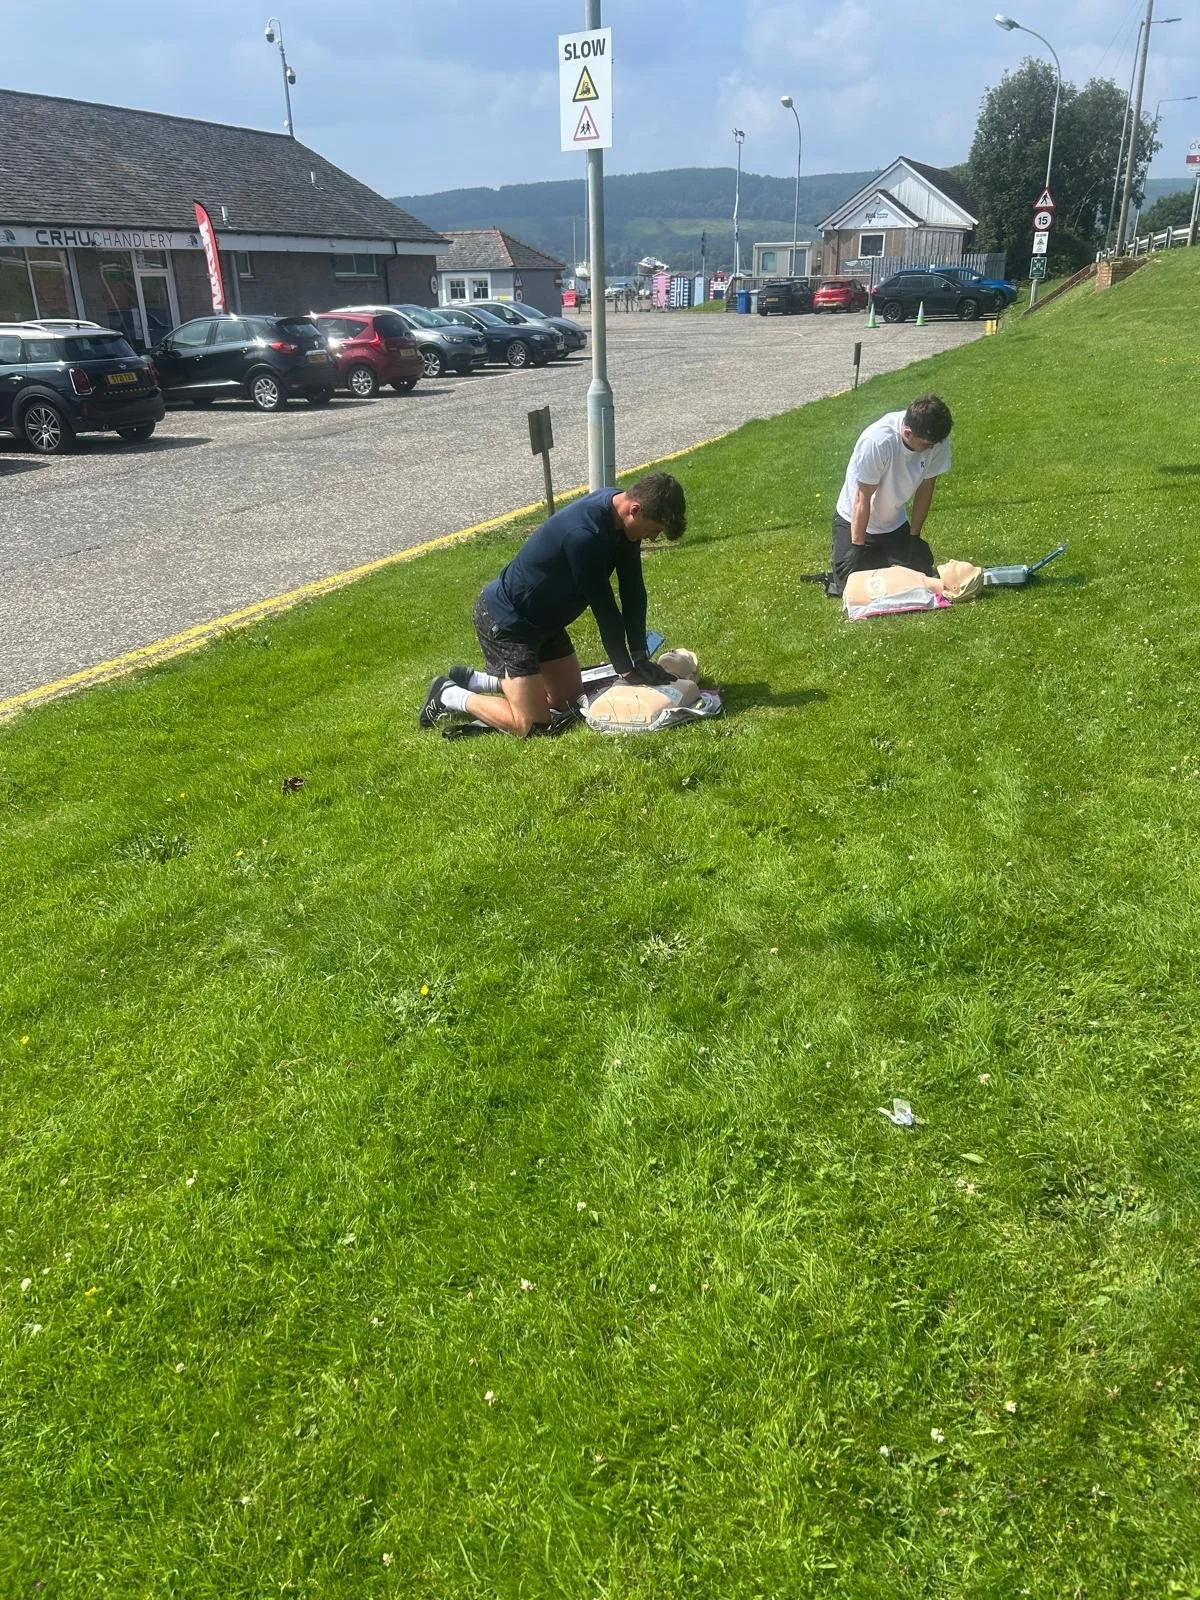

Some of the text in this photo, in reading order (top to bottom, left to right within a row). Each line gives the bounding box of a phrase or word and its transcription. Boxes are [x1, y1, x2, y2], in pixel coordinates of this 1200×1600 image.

[564, 38, 605, 60] SLOW
[1038, 216, 1048, 225] 15
[92, 231, 173, 248] CHANDLERY
